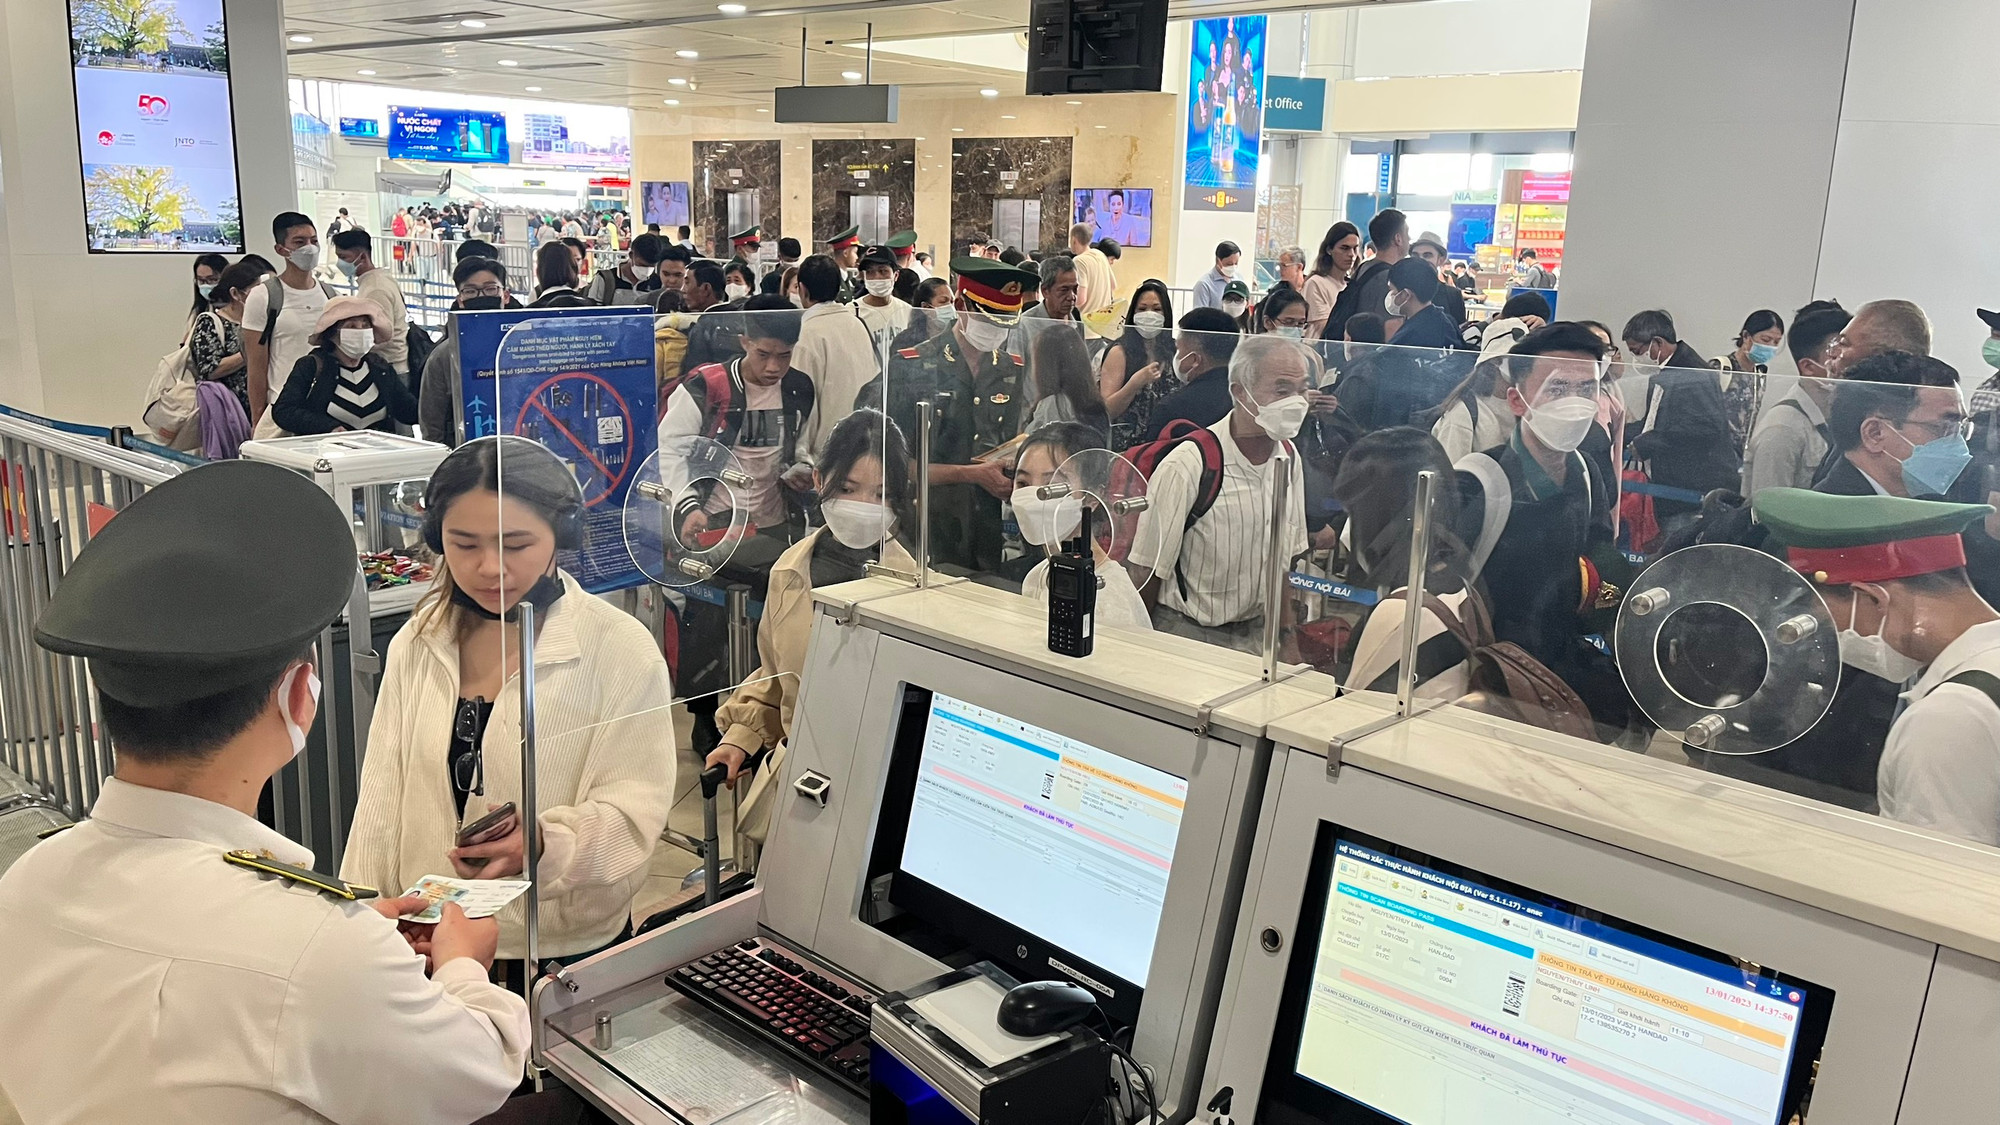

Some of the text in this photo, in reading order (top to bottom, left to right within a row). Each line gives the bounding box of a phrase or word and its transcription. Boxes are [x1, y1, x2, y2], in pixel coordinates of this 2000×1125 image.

[1275, 97, 1303, 110] Office
[175, 137, 195, 147] JNTO
[1454, 192, 1471, 201] NIA
[1315, 582, 1331, 593] NỘI
[1333, 586, 1351, 597] BÀI
[1023, 803, 1038, 813] KHÁCH
[1338, 842, 1348, 853] HỆ
[1348, 845, 1370, 860] THỐNG
[1370, 853, 1384, 864] XÁC
[1402, 864, 1421, 877] HÀNH
[1421, 870, 1444, 885] KHÁCH
[1472, 887, 1488, 900] (Ver
[1488, 892, 1521, 911] 5.1.1.17)
[1359, 890, 1369, 899] TIN
[1370, 894, 1386, 905] SCAN
[1386, 899, 1417, 916] BOARDING
[1417, 911, 1435, 923] PASS
[1370, 906, 1424, 930] NGUYEN/THUY LINH
[1380, 929, 1408, 944] 13/01/2023
[1016, 944, 1028, 959] hp
[1428, 946, 1455, 961] HAN-DAD
[1535, 977, 1577, 997] Boarding Gate:
[1537, 966, 1600, 993] NGUYEN/THUY LINH
[1539, 953, 1566, 968] THÔNG
[1565, 963, 1576, 972] TIN
[1661, 996, 1688, 1011] KHÔNG
[1551, 994, 1562, 1003] Ghi
[1705, 986, 1793, 1022] 13/01/2023 14:37:50
[1323, 985, 1338, 996] DANH
[1338, 991, 1352, 1001] SÁCH
[1450, 1036, 1461, 1046] TRA
[1478, 1048, 1496, 1060] QUAN
[1579, 1013, 1595, 1023] 17-C
[1581, 1006, 1668, 1042] 13/01/2023 VJ521 HANDAD
[1670, 1026, 1689, 1038] 11:10
[1469, 1019, 1567, 1065] KHÁCH ĐÃ LÀM THỦ TỤC
